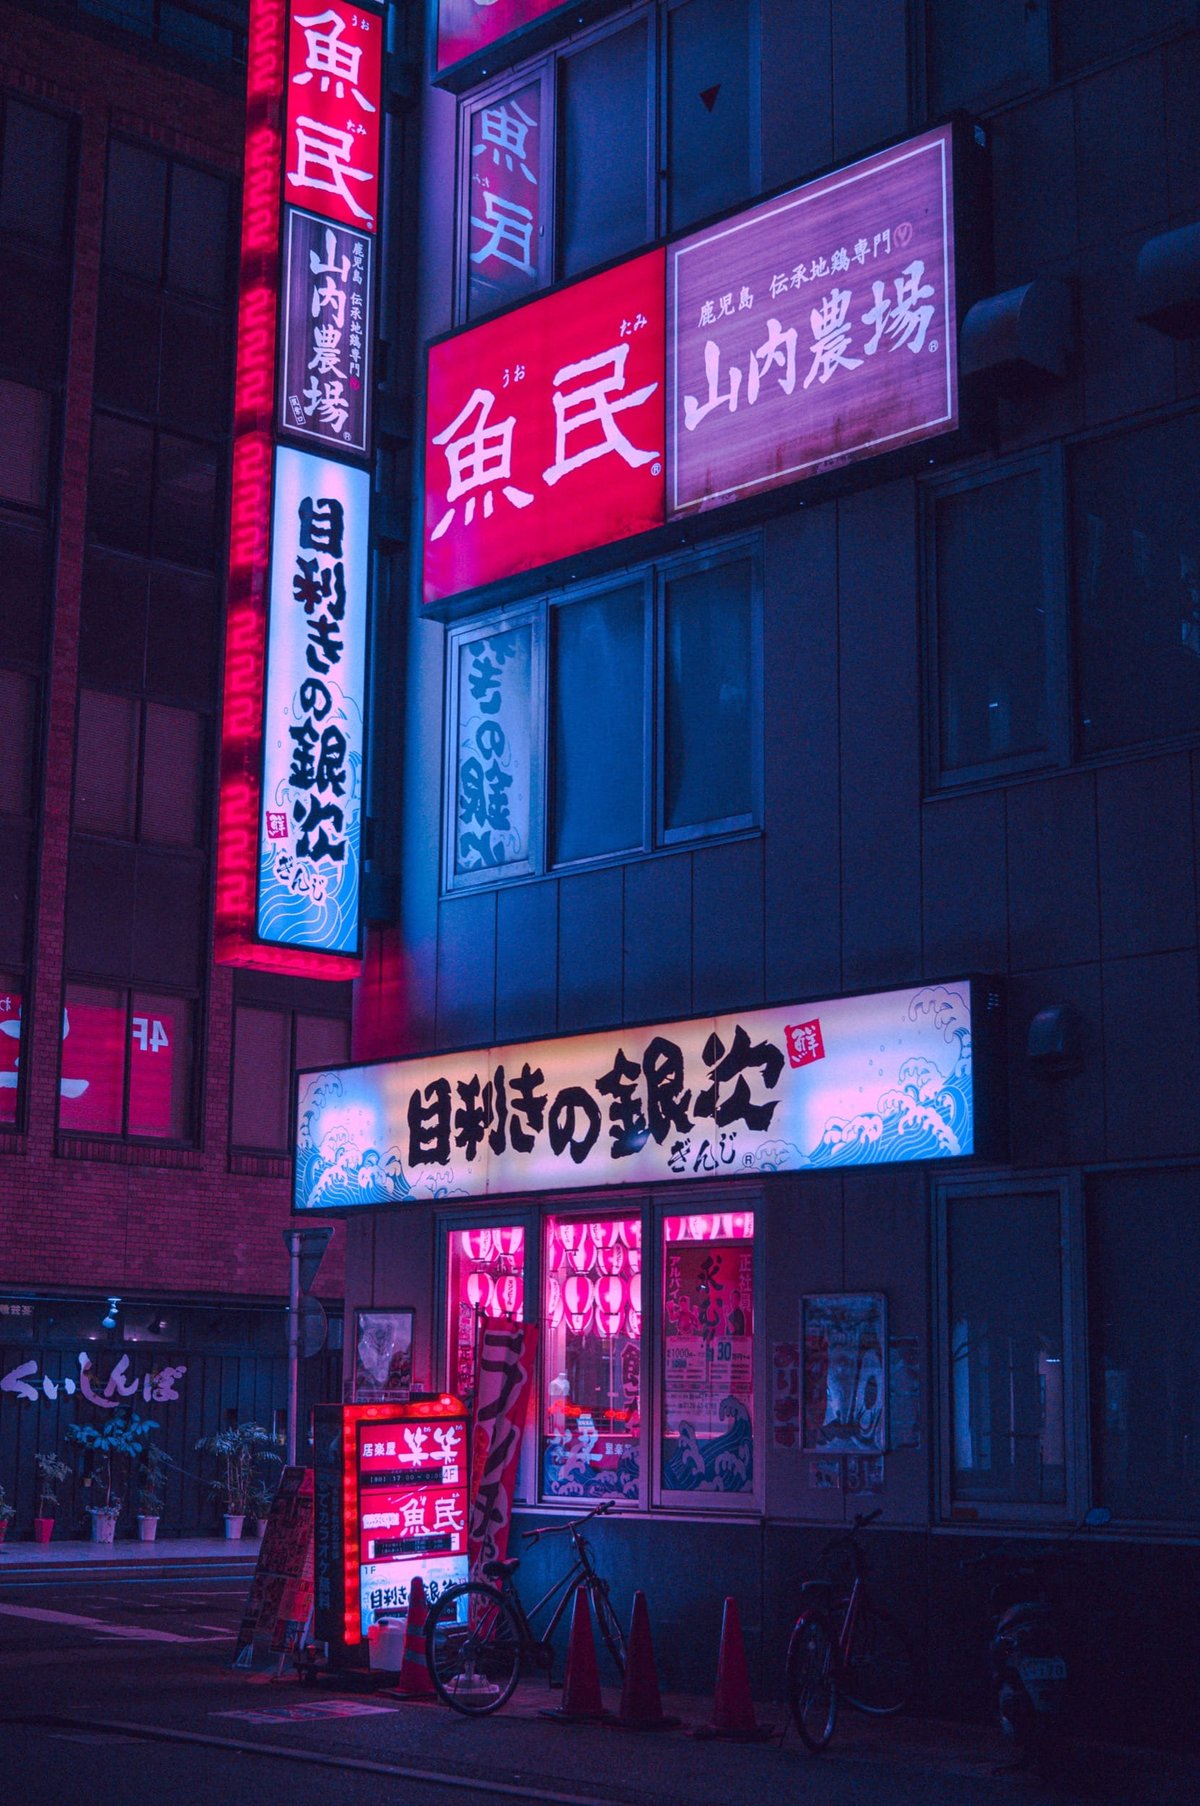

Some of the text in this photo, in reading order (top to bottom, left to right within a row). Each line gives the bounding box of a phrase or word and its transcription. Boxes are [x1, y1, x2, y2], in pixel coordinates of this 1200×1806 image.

[351, 14, 370, 31] うお
[287, 8, 376, 222] 魚民
[346, 119, 367, 136] たみ
[349, 241, 365, 378] 鹿児島 伝承地鶏専門
[619, 313, 648, 337] たみ
[697, 228, 891, 328] 鹿児島 伝承地鶏専門
[302, 229, 351, 433] 山内農場
[502, 363, 526, 388] うお
[684, 259, 936, 432] 山内農場
[430, 342, 661, 543] 魚民
[289, 496, 348, 866] 目利きの銀次
[790, 1021, 825, 1066] 鮮
[407, 1024, 786, 1168] 目利きの銀次
[665, 1131, 736, 1174] ぎんじ
[399, 1497, 464, 1538] 魚民
